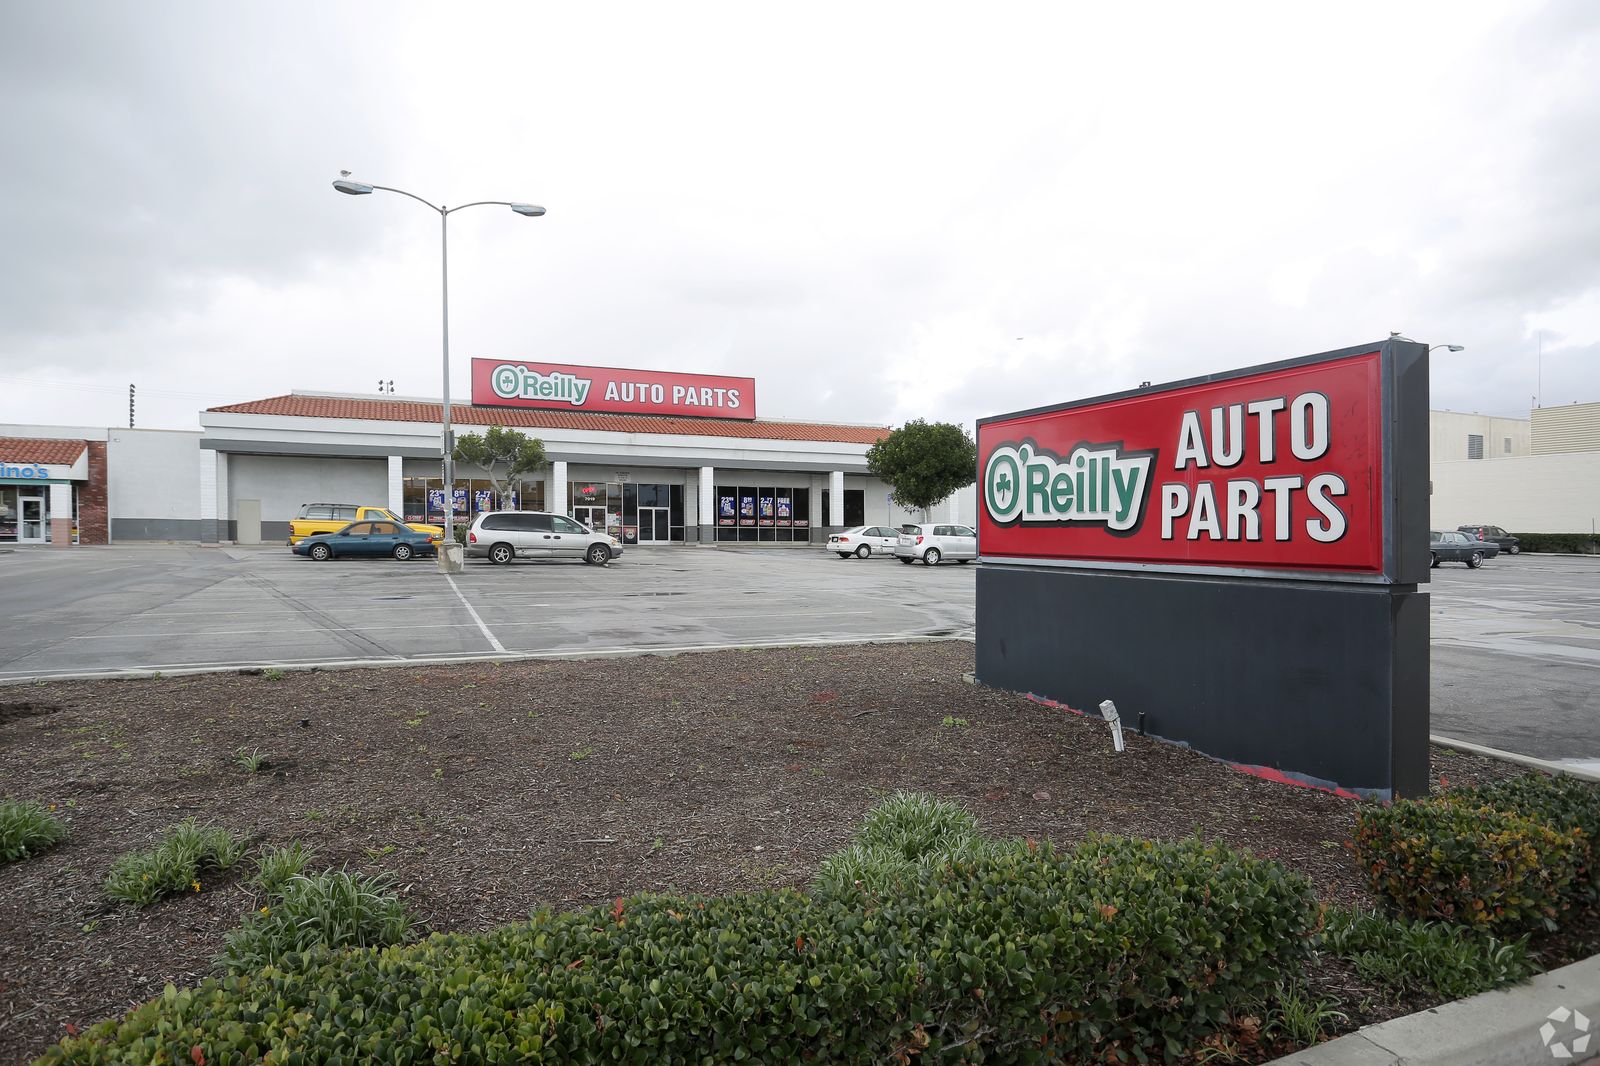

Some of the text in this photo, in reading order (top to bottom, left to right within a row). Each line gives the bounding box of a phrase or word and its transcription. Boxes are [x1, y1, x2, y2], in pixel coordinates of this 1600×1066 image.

[493, 366, 740, 409] O'Reilly AUTO PARTS
[1174, 392, 1330, 469] AUTO
[986, 445, 1144, 525] O'Reilly
[1161, 473, 1348, 543] PARTS
